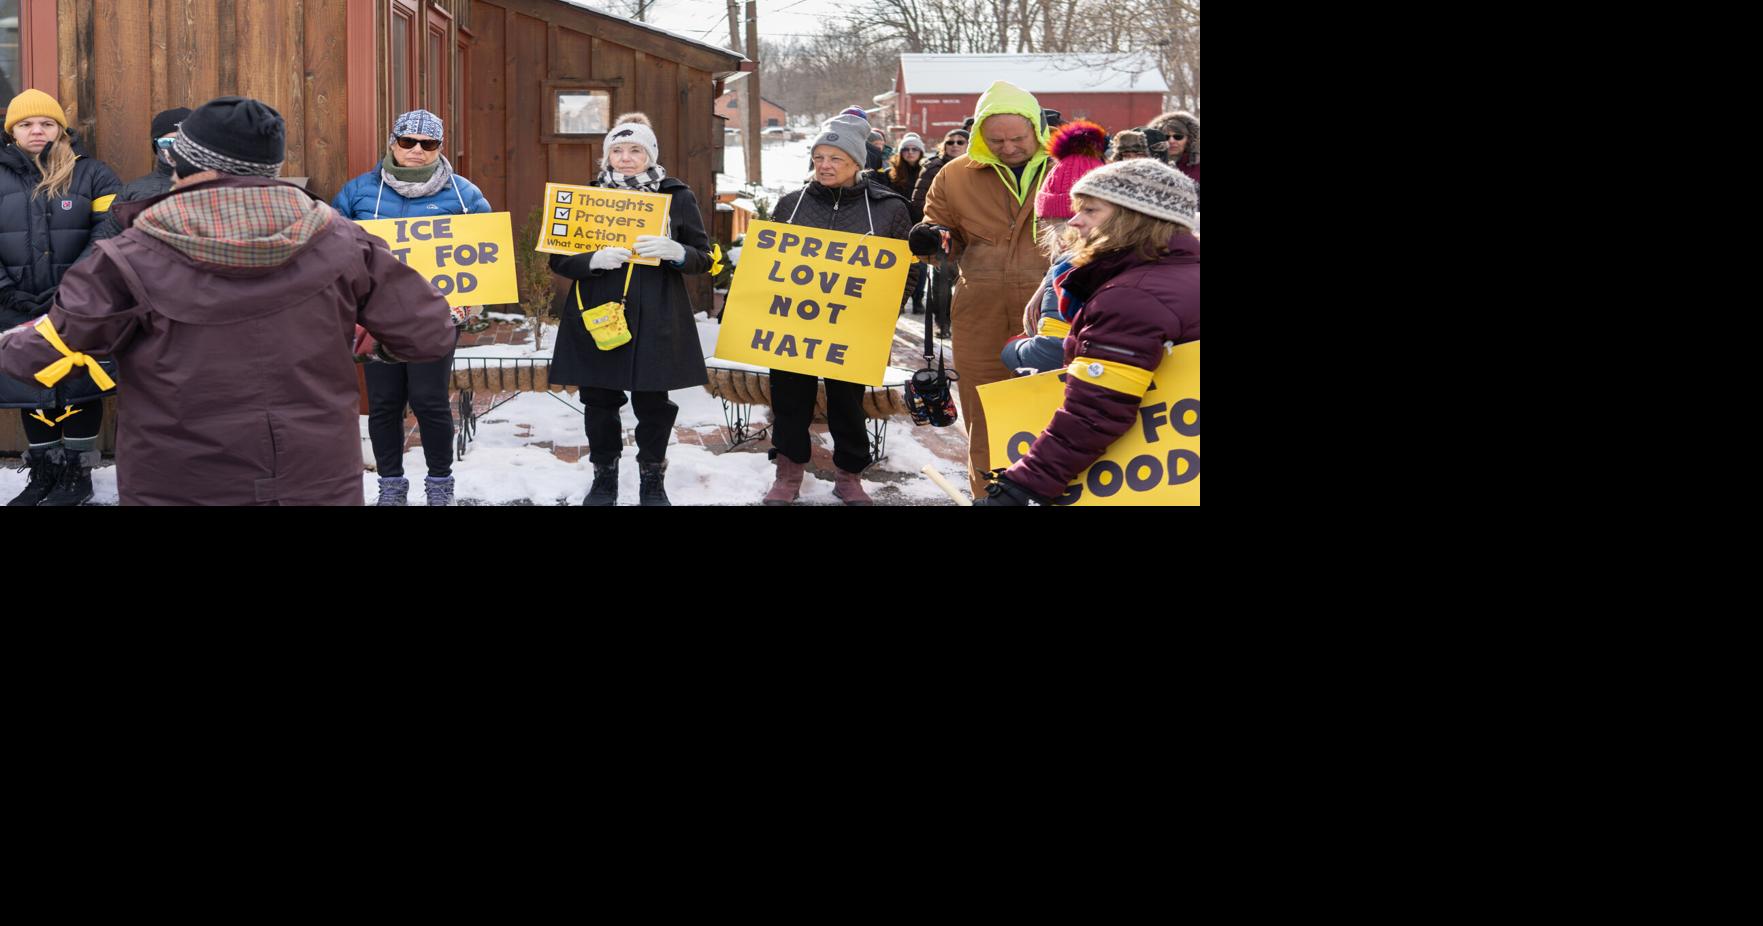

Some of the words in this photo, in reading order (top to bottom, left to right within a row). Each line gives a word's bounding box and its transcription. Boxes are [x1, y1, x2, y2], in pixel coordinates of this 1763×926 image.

[578, 193, 654, 212] Thoughts
[394, 218, 453, 243] ICE
[575, 210, 646, 228] Prayers
[546, 238, 571, 248] What
[573, 226, 627, 243] Action
[435, 242, 499, 268] FOR
[756, 229, 897, 270] SPREAD
[430, 272, 478, 296] OD
[767, 260, 867, 298] LOVE
[769, 294, 847, 325] NOT
[750, 328, 849, 366] HATE
[1139, 397, 1200, 444] FO
